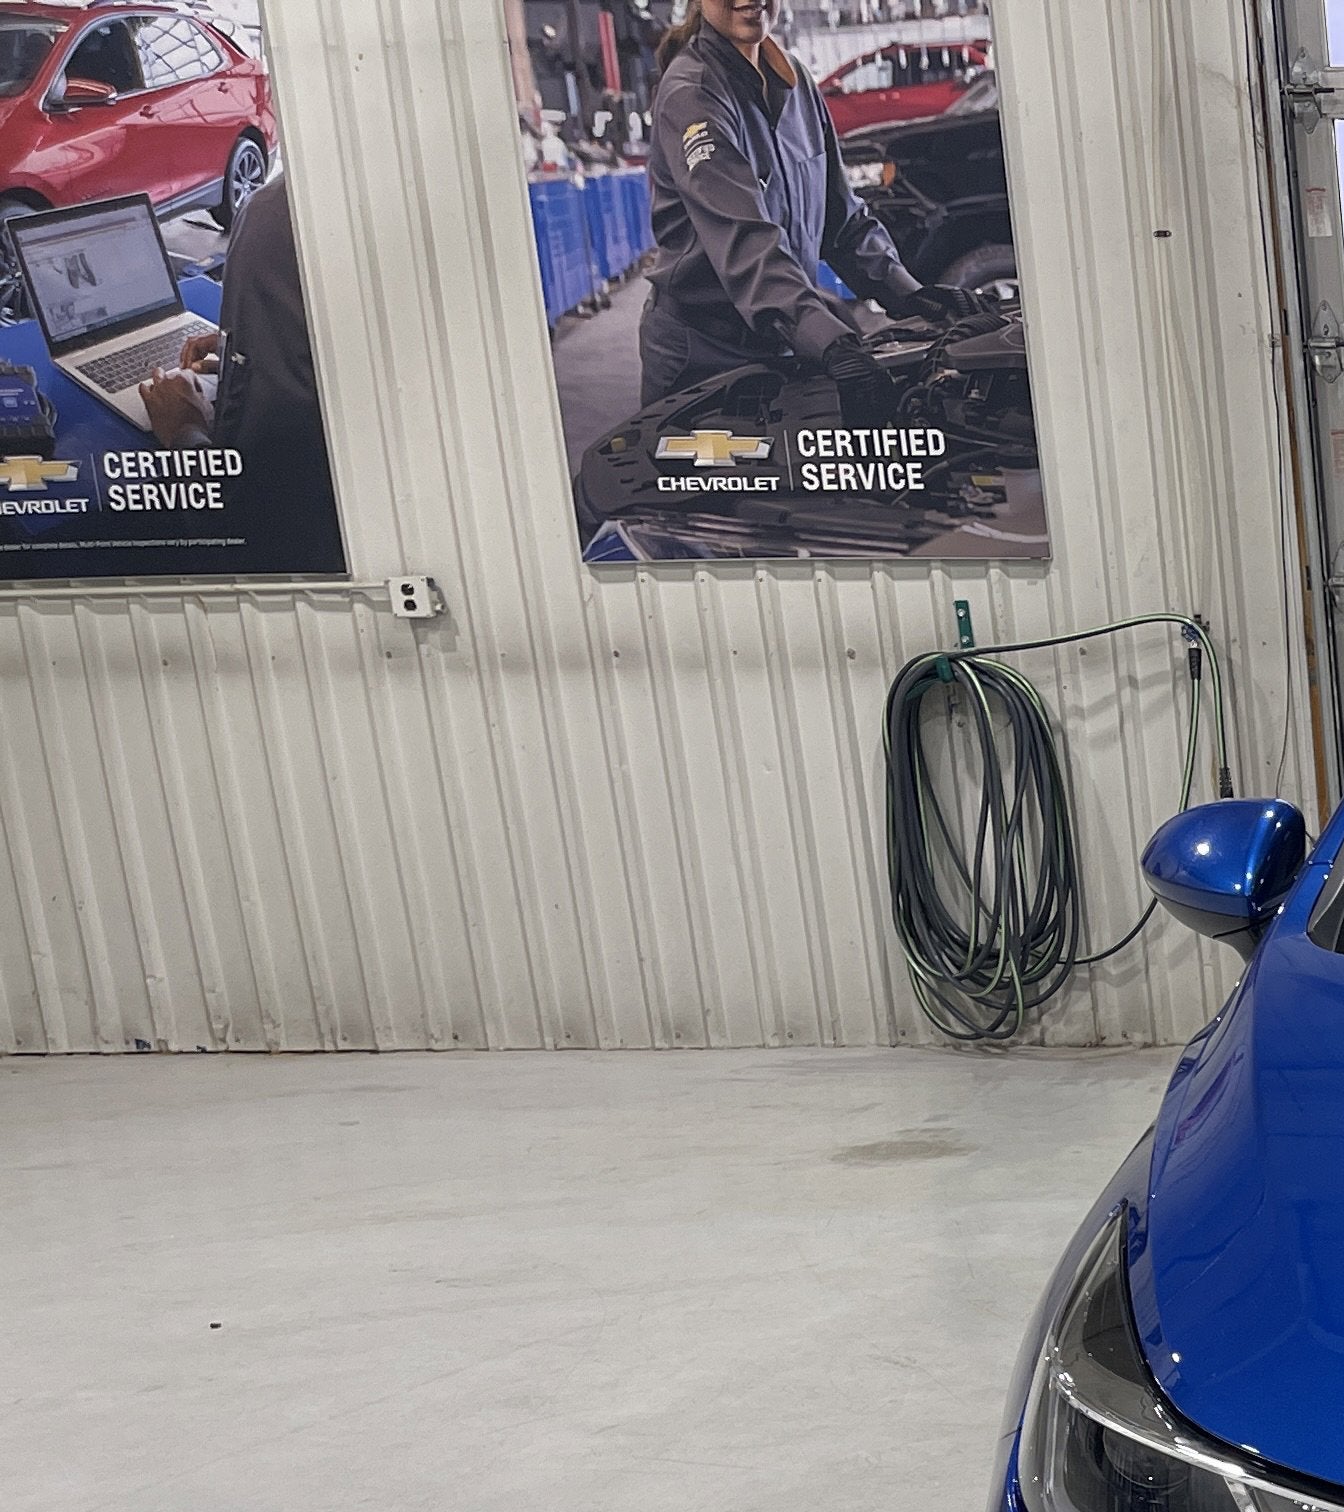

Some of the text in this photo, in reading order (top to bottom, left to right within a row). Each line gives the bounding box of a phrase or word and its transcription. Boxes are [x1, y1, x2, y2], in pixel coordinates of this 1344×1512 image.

[797, 429, 946, 457] CERTIFIED
[103, 449, 243, 479] CERTIFIED
[802, 462, 925, 491] SERVICE
[108, 482, 225, 511] SERVICE
[657, 476, 780, 492] CHEVROLET
[0, 498, 90, 515] EVROLET
